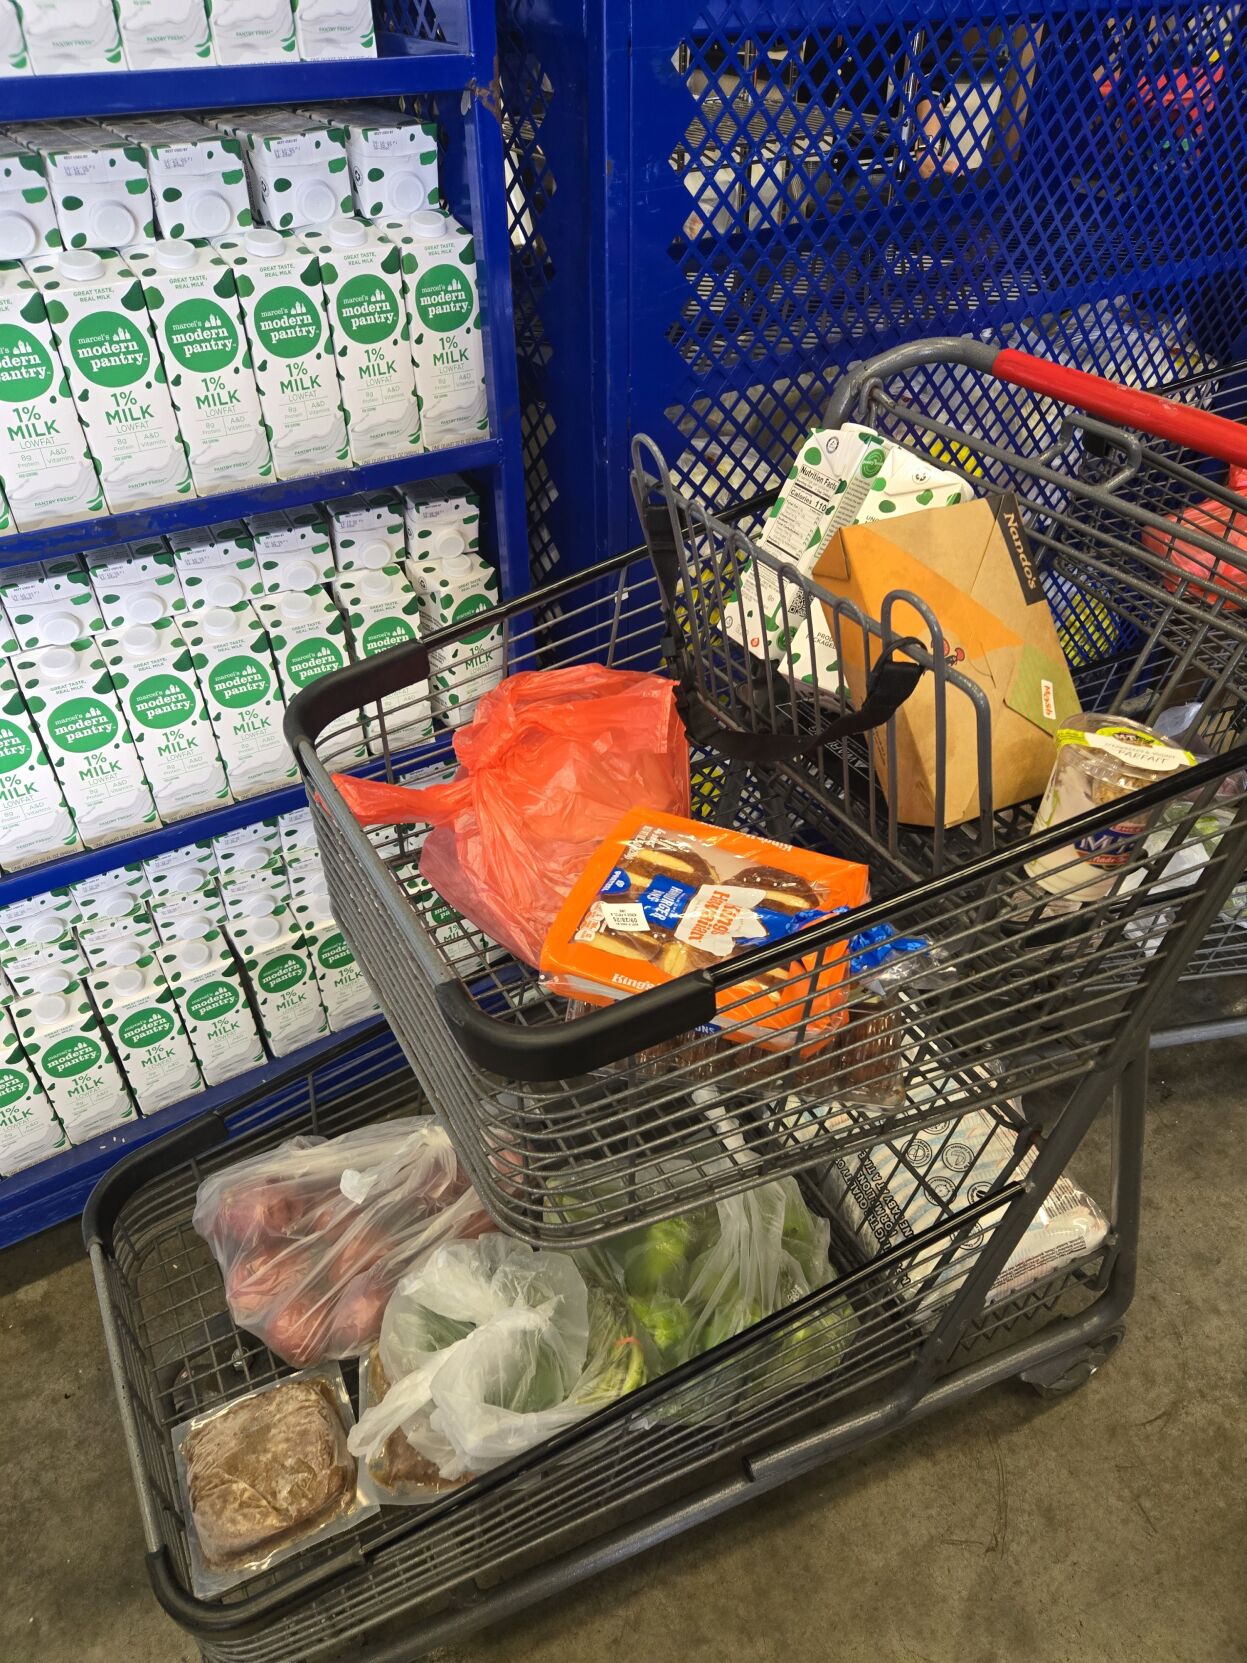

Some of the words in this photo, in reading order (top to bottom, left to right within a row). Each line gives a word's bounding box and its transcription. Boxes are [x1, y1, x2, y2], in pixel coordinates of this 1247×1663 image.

[420, 291, 466, 305] modern
[342, 301, 391, 317] modern
[428, 301, 469, 317] pantry
[172, 320, 202, 331] marcel's
[260, 315, 312, 330] modern
[351, 312, 394, 329] pantry
[79, 334, 109, 344] marcel's
[172, 328, 228, 343] modern
[271, 325, 316, 343] pantry
[439, 336, 458, 350] 1%
[77, 342, 138, 358] modern
[183, 338, 233, 357] pantry
[364, 347, 384, 363] 1%
[0, 354, 42, 368] dern
[92, 353, 144, 372] pantry
[433, 348, 469, 366] MILK
[0, 366, 46, 381] antry
[285, 362, 308, 377] 1%
[358, 360, 397, 379] MILK
[201, 376, 225, 392] 1%
[280, 375, 321, 394] MILK
[111, 391, 137, 407] 1%
[196, 390, 240, 409] MILK
[12, 406, 41, 422] 1%
[105, 405, 154, 425] MILK
[205, 406, 236, 417] LOWFAT
[7, 420, 60, 441] MILK
[116, 421, 150, 433] LOWFAT
[19, 437, 56, 449] LOWFAT
[801, 465, 823, 484] Nutrition
[824, 477, 837, 490] Facts
[790, 489, 812, 504] Calories
[815, 501, 827, 512] 110
[1004, 512, 1036, 590] Nando's
[367, 634, 409, 650] modern
[291, 654, 336, 672] modern
[300, 663, 339, 679] pantry
[215, 673, 263, 691] modern
[224, 681, 265, 699] pantry
[136, 693, 187, 711] modern
[146, 701, 190, 719] pantry
[238, 709, 258, 722] 1%
[55, 715, 108, 735] modern
[66, 723, 112, 743] pantry
[233, 717, 271, 735] MILK
[162, 729, 184, 742] 1%
[158, 737, 198, 756] MILK
[84, 752, 106, 766] 1%
[79, 760, 122, 781] MILK
[262, 964, 300, 983] modern
[270, 970, 303, 987] pantry
[192, 991, 232, 1010] modern
[276, 993, 306, 1011] MILK
[281, 990, 296, 1000] 1%
[199, 996, 234, 1015] pantry
[124, 1018, 167, 1038] modern
[208, 1021, 240, 1040] MILK
[212, 1017, 229, 1029] 1%
[132, 1023, 170, 1042] pantry
[48, 1047, 93, 1068] modern
[141, 1048, 176, 1067] MILK
[146, 1045, 164, 1056] 1%
[56, 1052, 96, 1072] pantry
[68, 1077, 104, 1096] MILK
[72, 1074, 91, 1086] 1%
